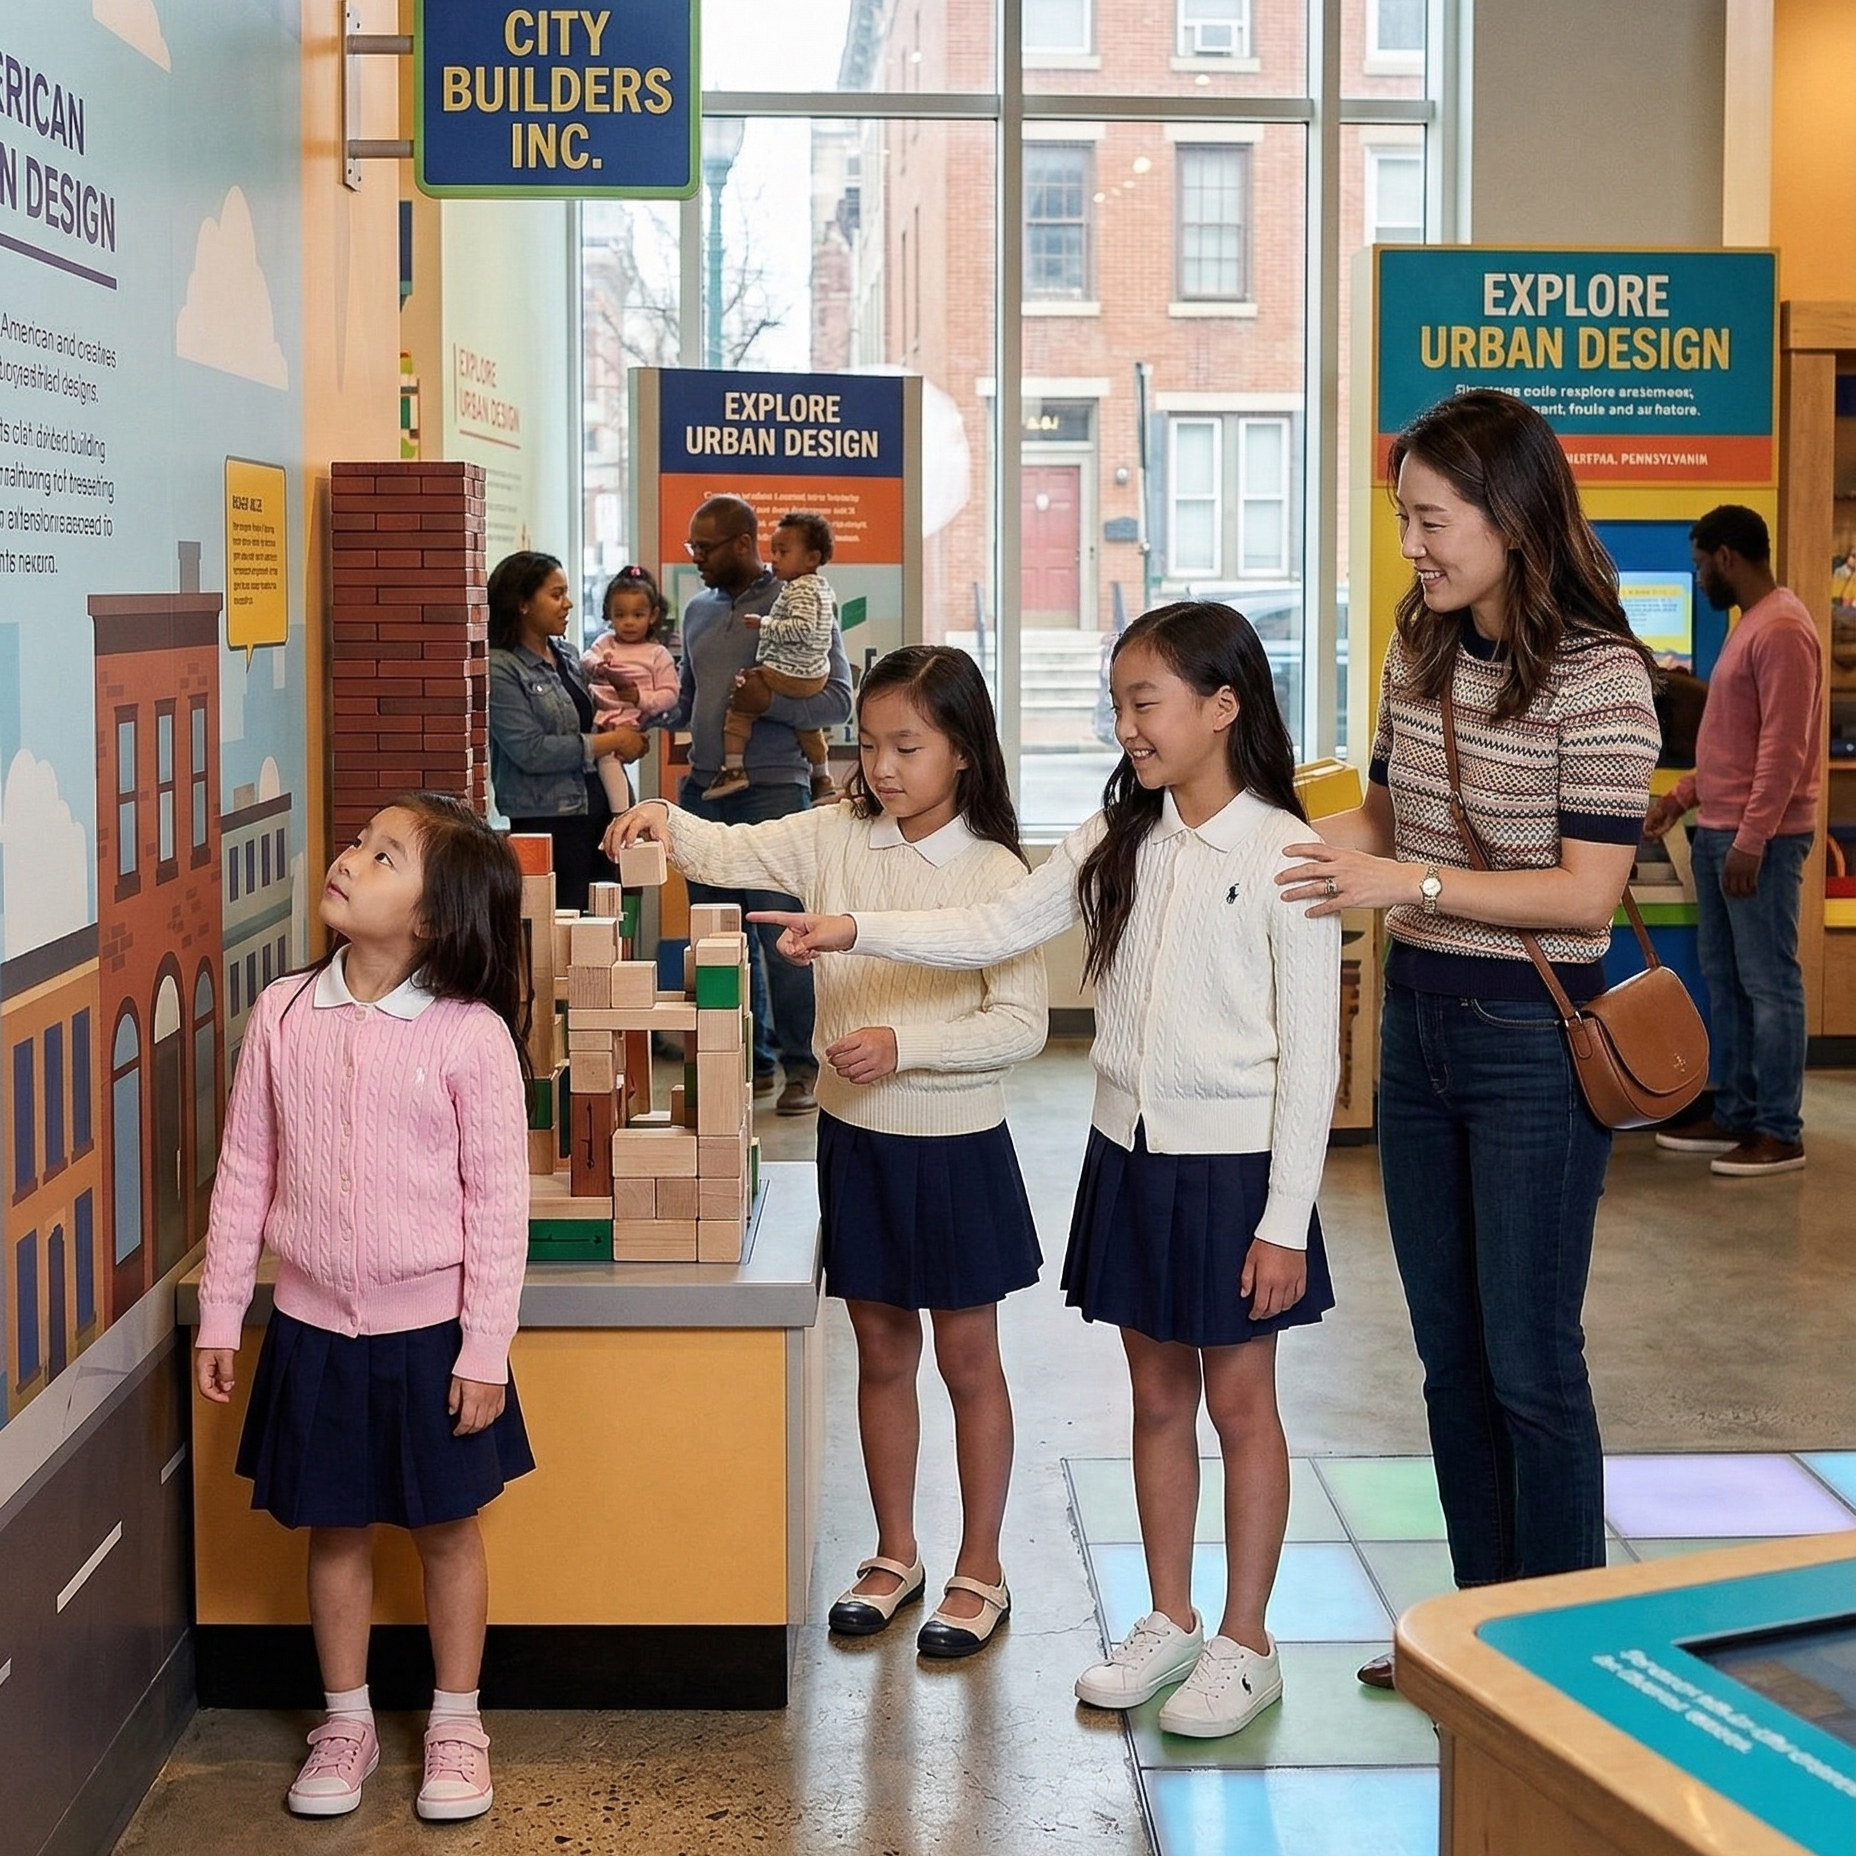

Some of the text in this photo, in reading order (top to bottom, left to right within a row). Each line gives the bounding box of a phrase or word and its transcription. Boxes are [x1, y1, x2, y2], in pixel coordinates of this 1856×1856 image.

[504, 9, 611, 57] CITY
[0, 52, 85, 156] RICAN
[442, 66, 673, 115] BUILDERS
[511, 122, 602, 170] INC.
[26, 155, 115, 253] DESIGN
[1483, 273, 1669, 318] EXPLORE
[0, 312, 54, 351] American
[57, 332, 75, 357] and
[1421, 325, 1731, 371] URBAN DESIGN
[724, 391, 841, 423] EXPLORE
[1609, 404, 1634, 416] and
[686, 425, 879, 458] URBAN DESIGN
